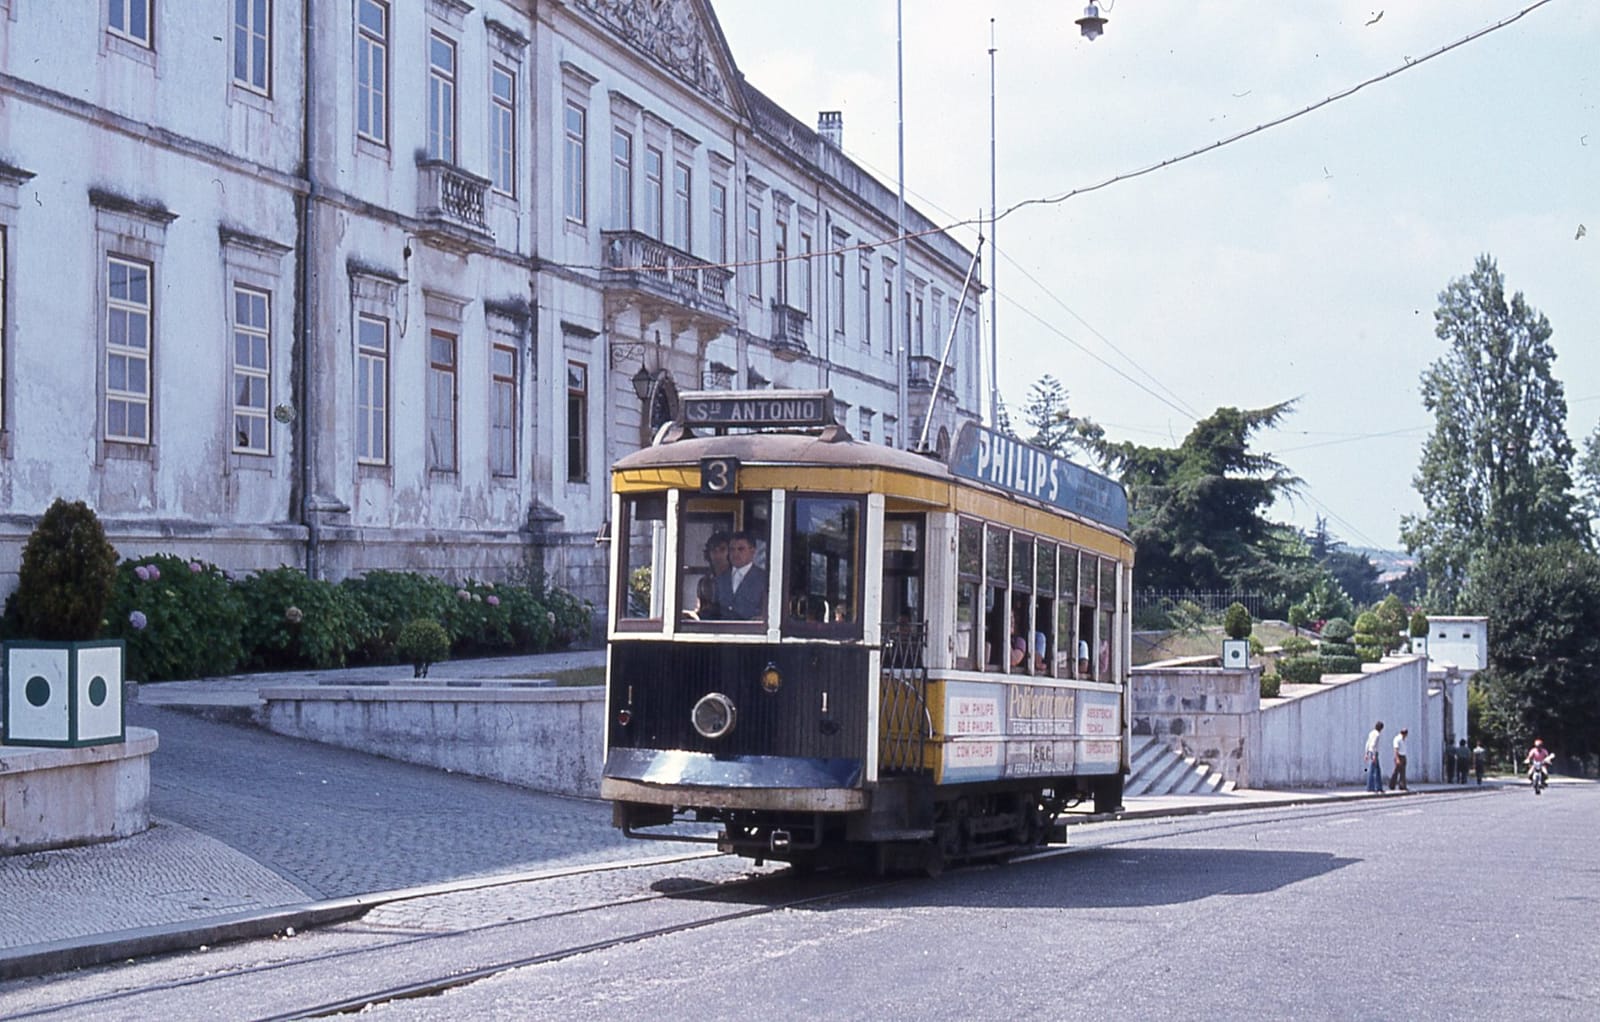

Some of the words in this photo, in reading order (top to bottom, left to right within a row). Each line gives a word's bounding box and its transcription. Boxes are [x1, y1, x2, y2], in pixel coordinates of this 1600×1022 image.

[731, 401, 815, 420] ANTONIO
[977, 430, 1059, 502] PHILIPS
[707, 460, 728, 491] 3
[972, 703, 994, 716] PHILIPS
[972, 720, 993, 733] PHILIPS
[972, 745, 993, 758] PHILIPS
